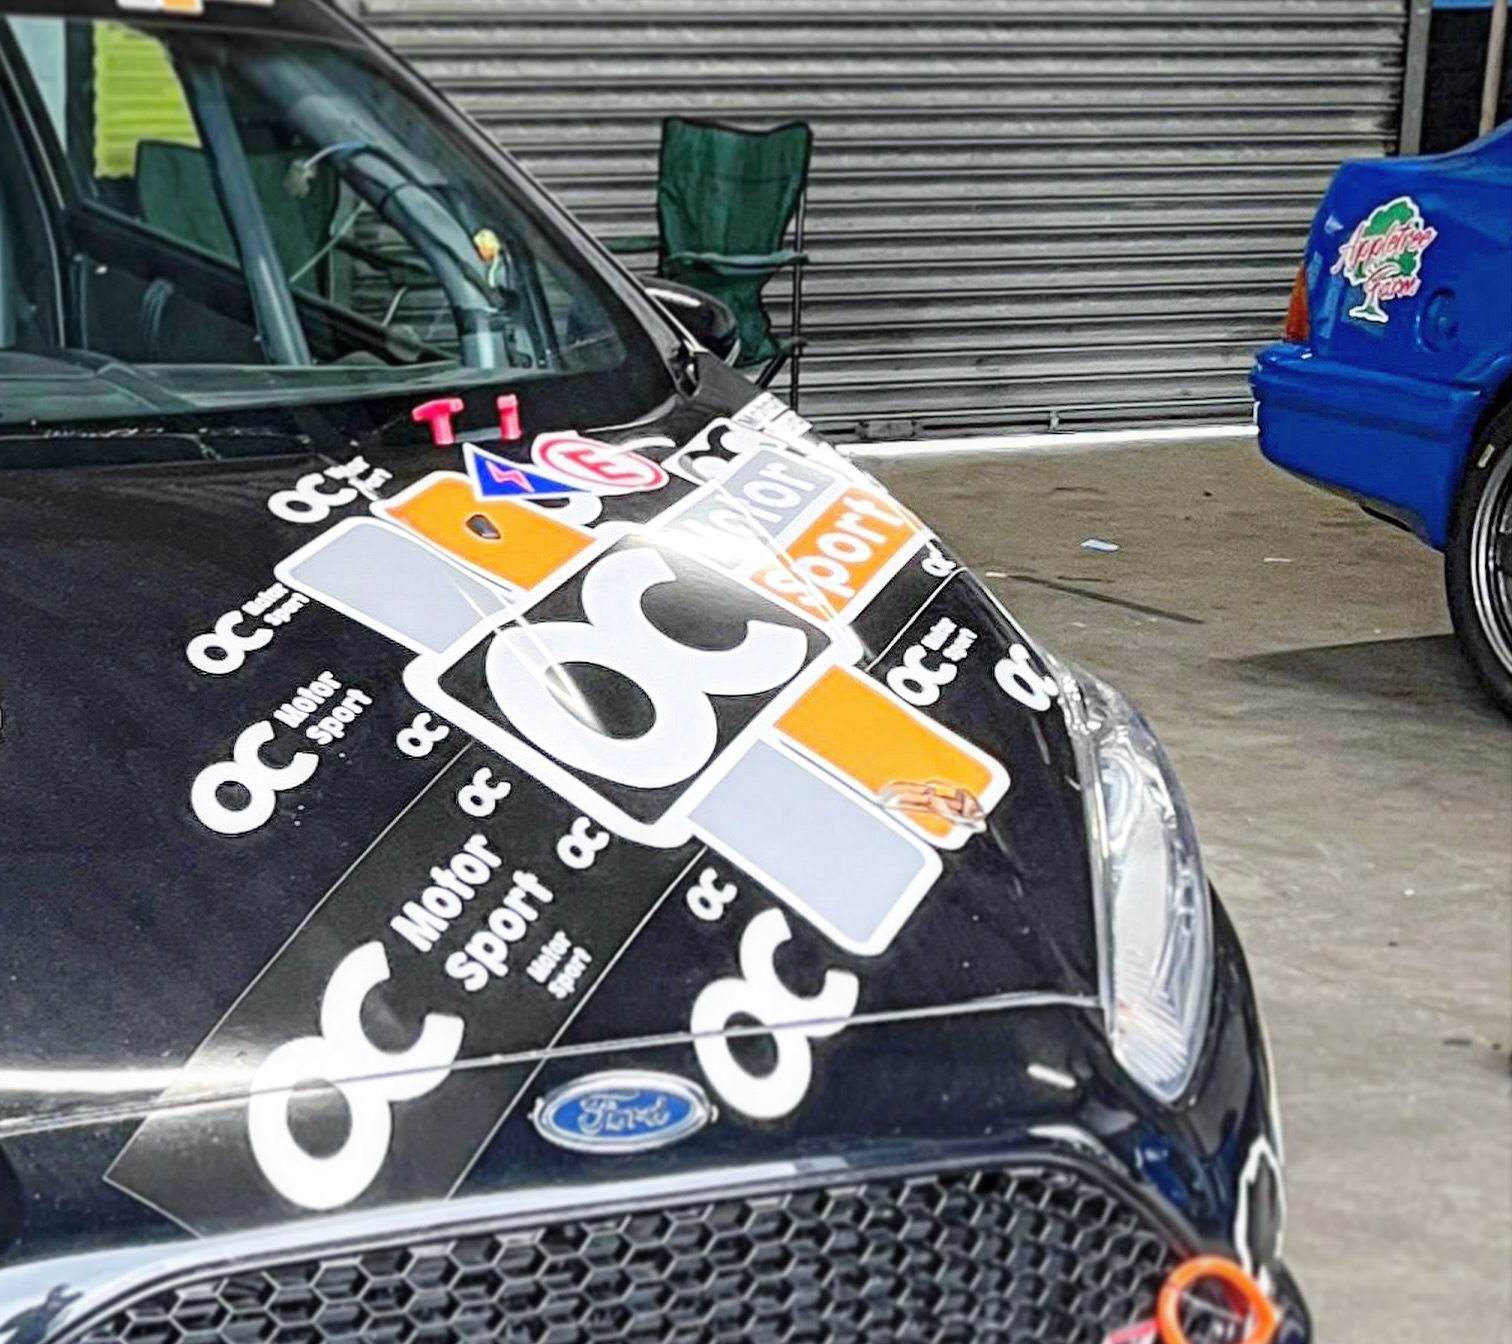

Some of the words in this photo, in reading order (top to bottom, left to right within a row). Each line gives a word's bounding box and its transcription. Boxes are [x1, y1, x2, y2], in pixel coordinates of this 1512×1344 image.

[272, 670, 342, 729] Motor
[305, 688, 373, 745] sport
[390, 833, 502, 953] Motor
[444, 870, 555, 992] sport
[578, 1089, 672, 1136] Ford
